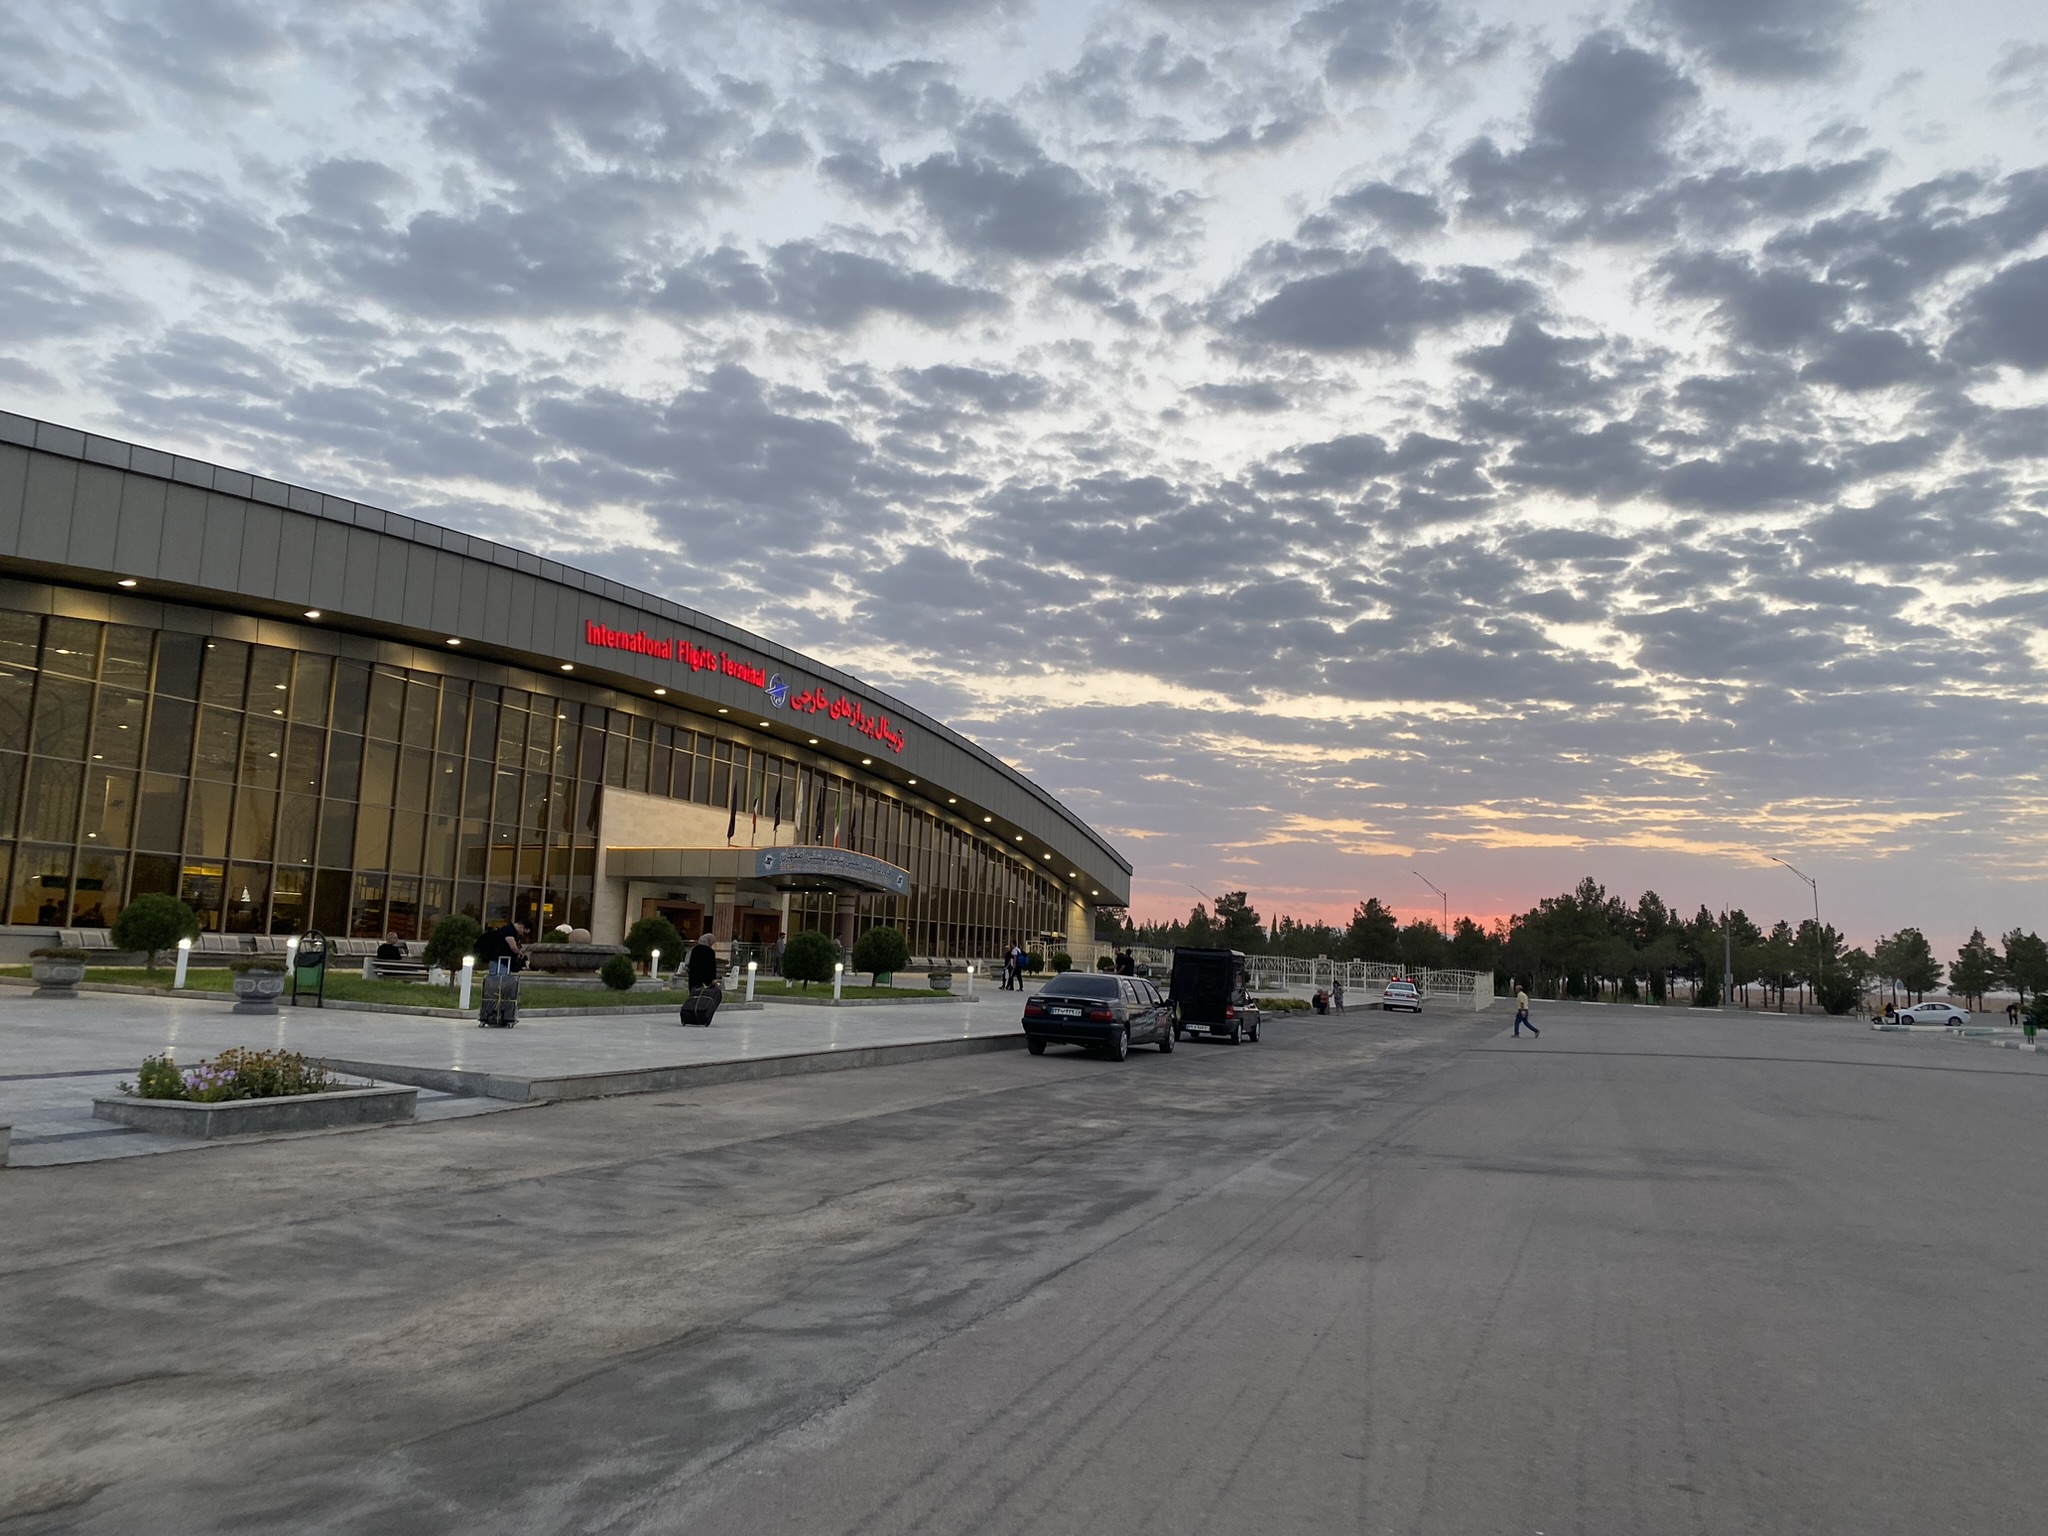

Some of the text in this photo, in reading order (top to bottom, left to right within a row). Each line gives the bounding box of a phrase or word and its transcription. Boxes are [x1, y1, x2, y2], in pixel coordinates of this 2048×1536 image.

[585, 619, 766, 688] International Flights Terminal
[789, 687, 829, 715] خارجی
[874, 715, 905, 754] ترمینال
